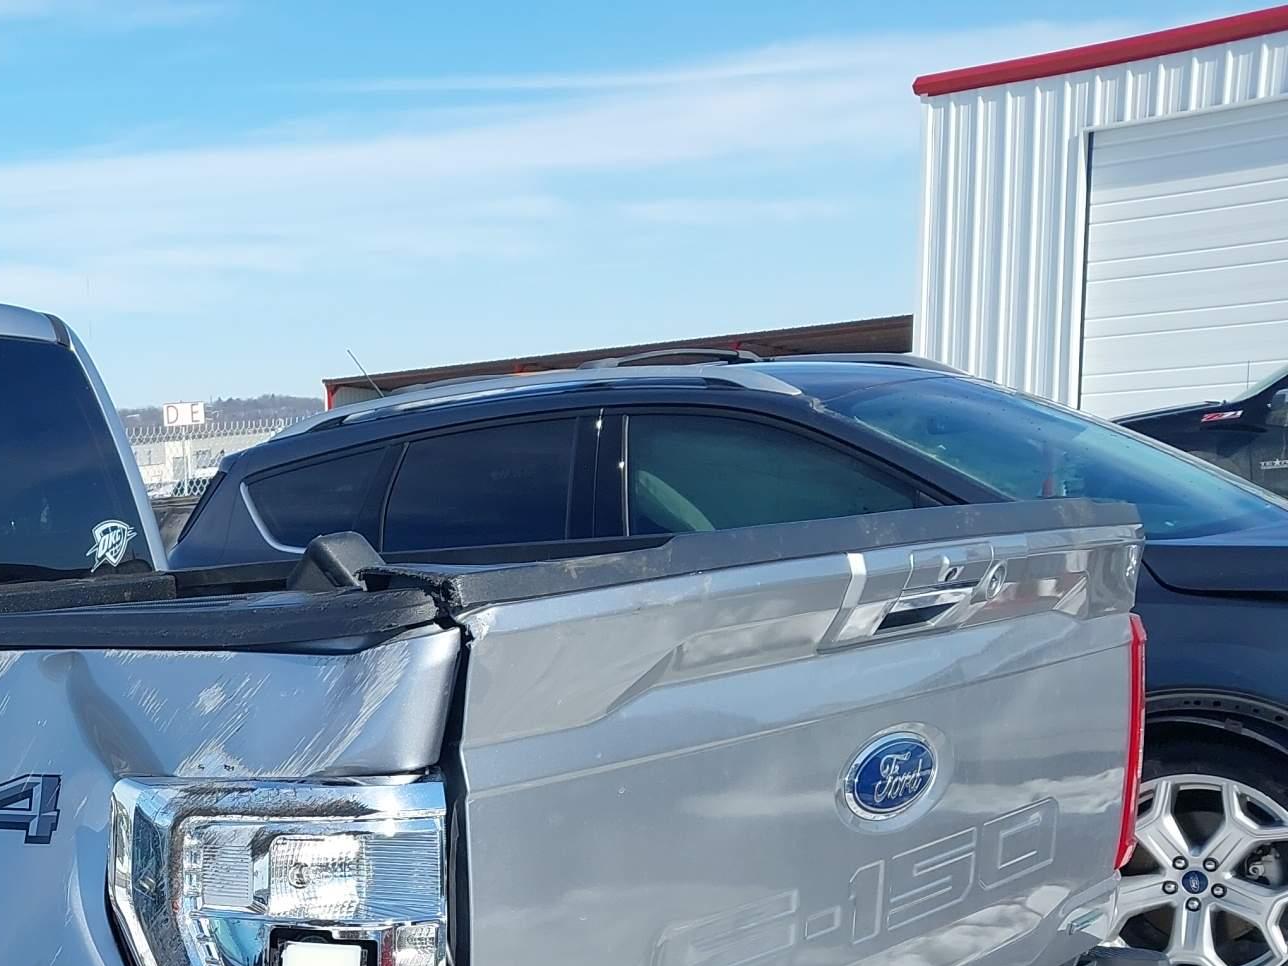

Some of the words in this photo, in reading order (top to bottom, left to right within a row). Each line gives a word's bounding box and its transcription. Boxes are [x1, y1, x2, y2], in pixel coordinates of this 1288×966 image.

[166, 404, 179, 424] D
[190, 403, 200, 423] E
[97, 529, 122, 559] OKC
[874, 751, 923, 803] Ford
